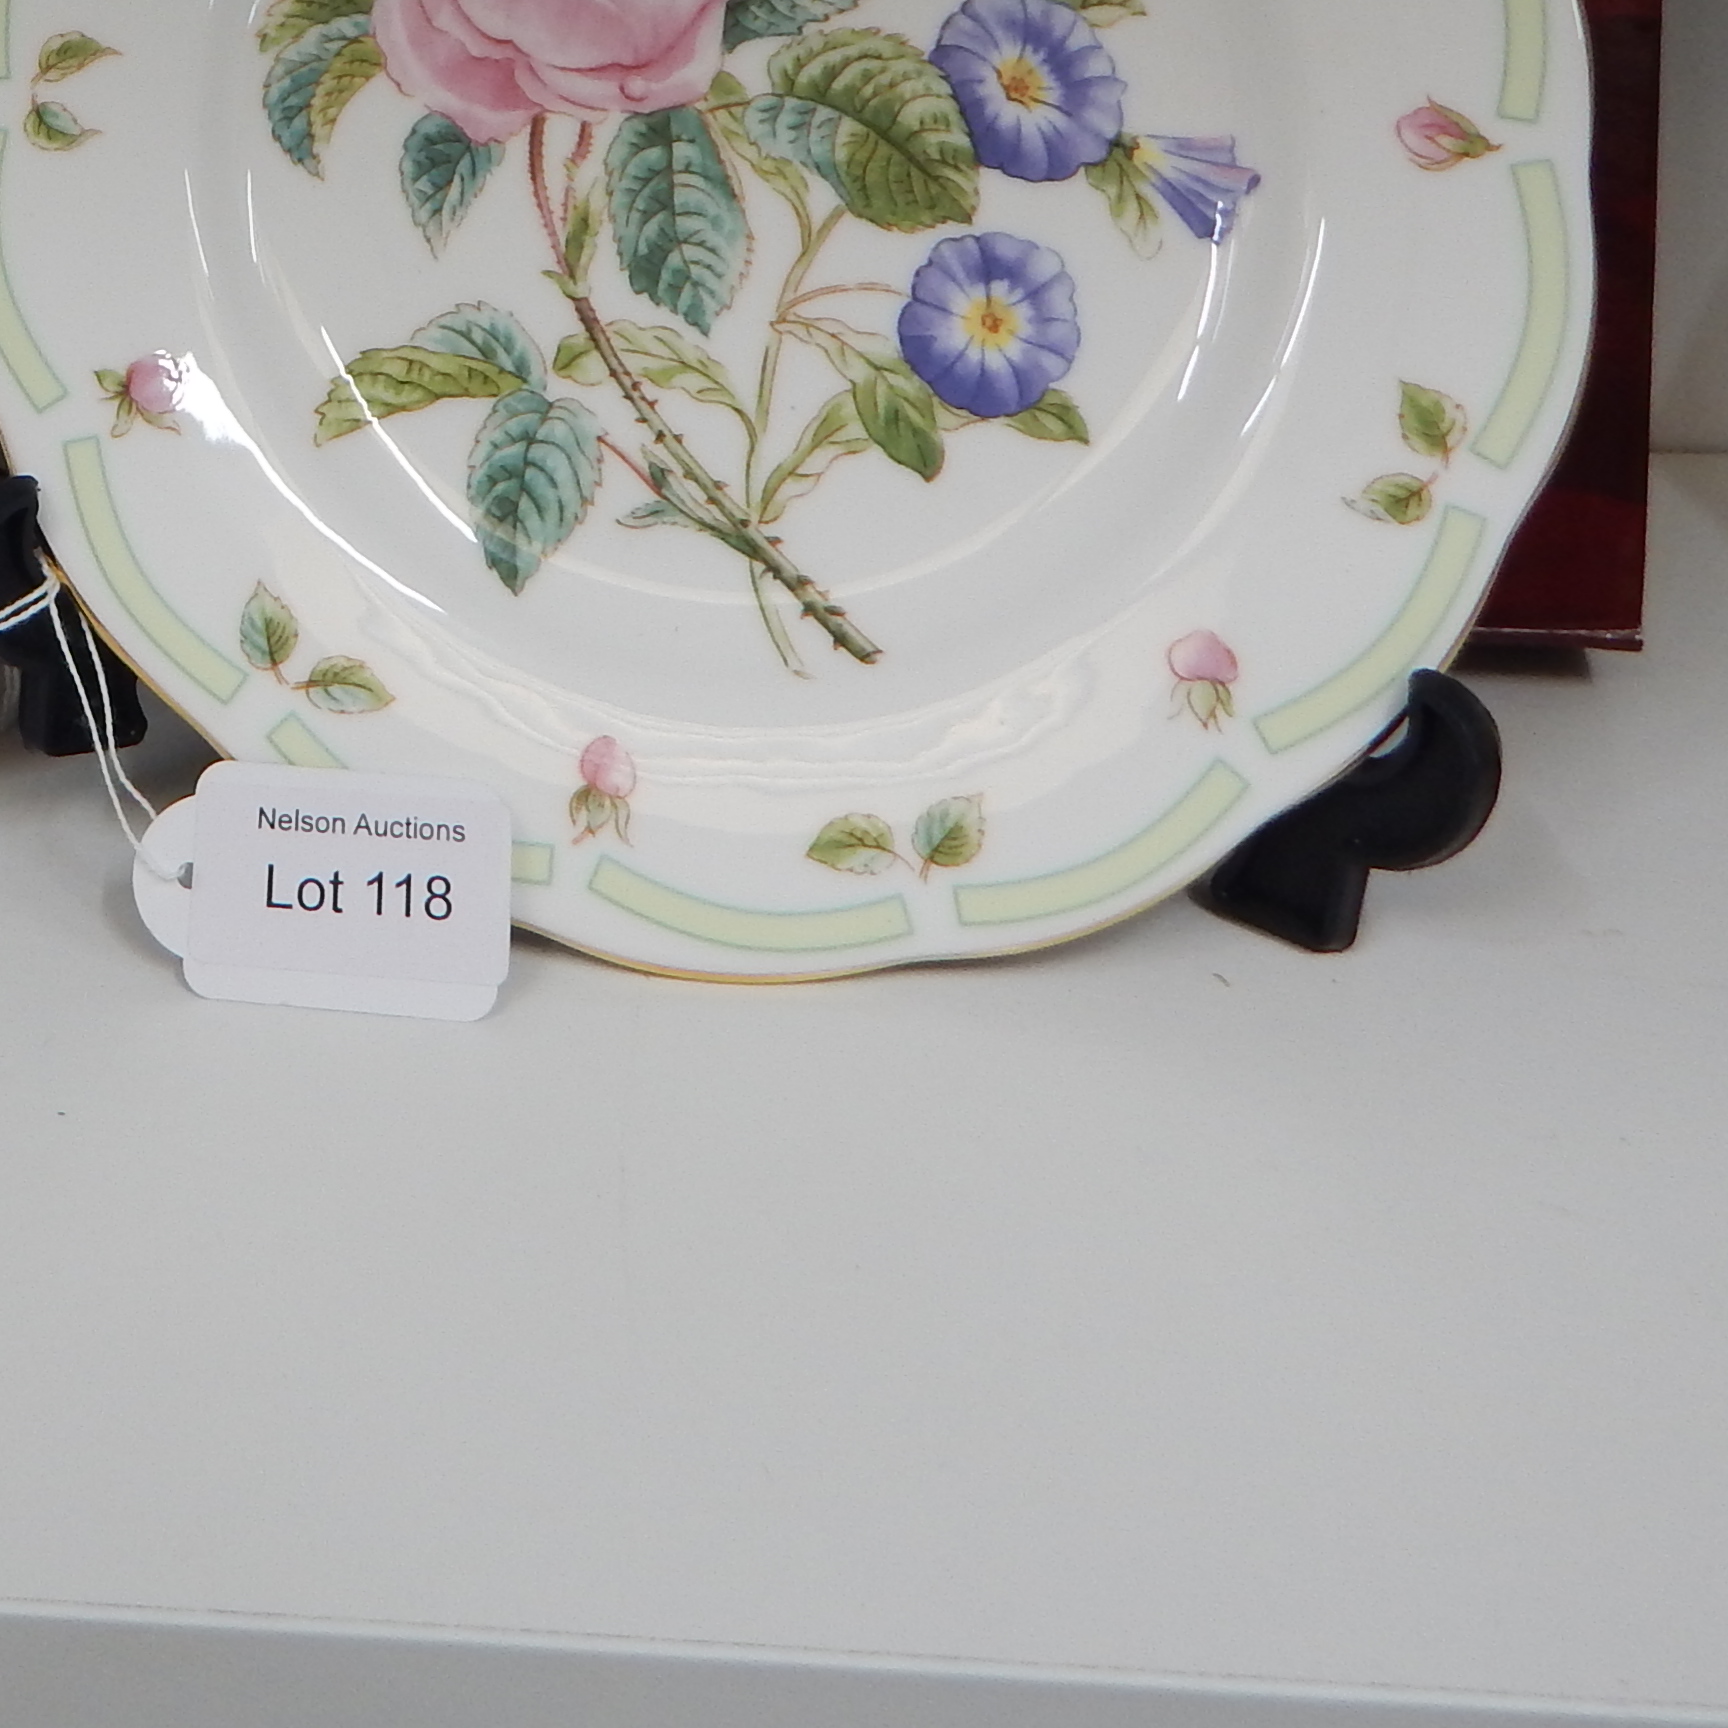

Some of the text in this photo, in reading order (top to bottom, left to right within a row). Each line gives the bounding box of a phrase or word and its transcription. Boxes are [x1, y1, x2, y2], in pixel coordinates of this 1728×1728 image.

[257, 807, 466, 842] Nelson Auctions
[265, 864, 452, 921] Lot 118
